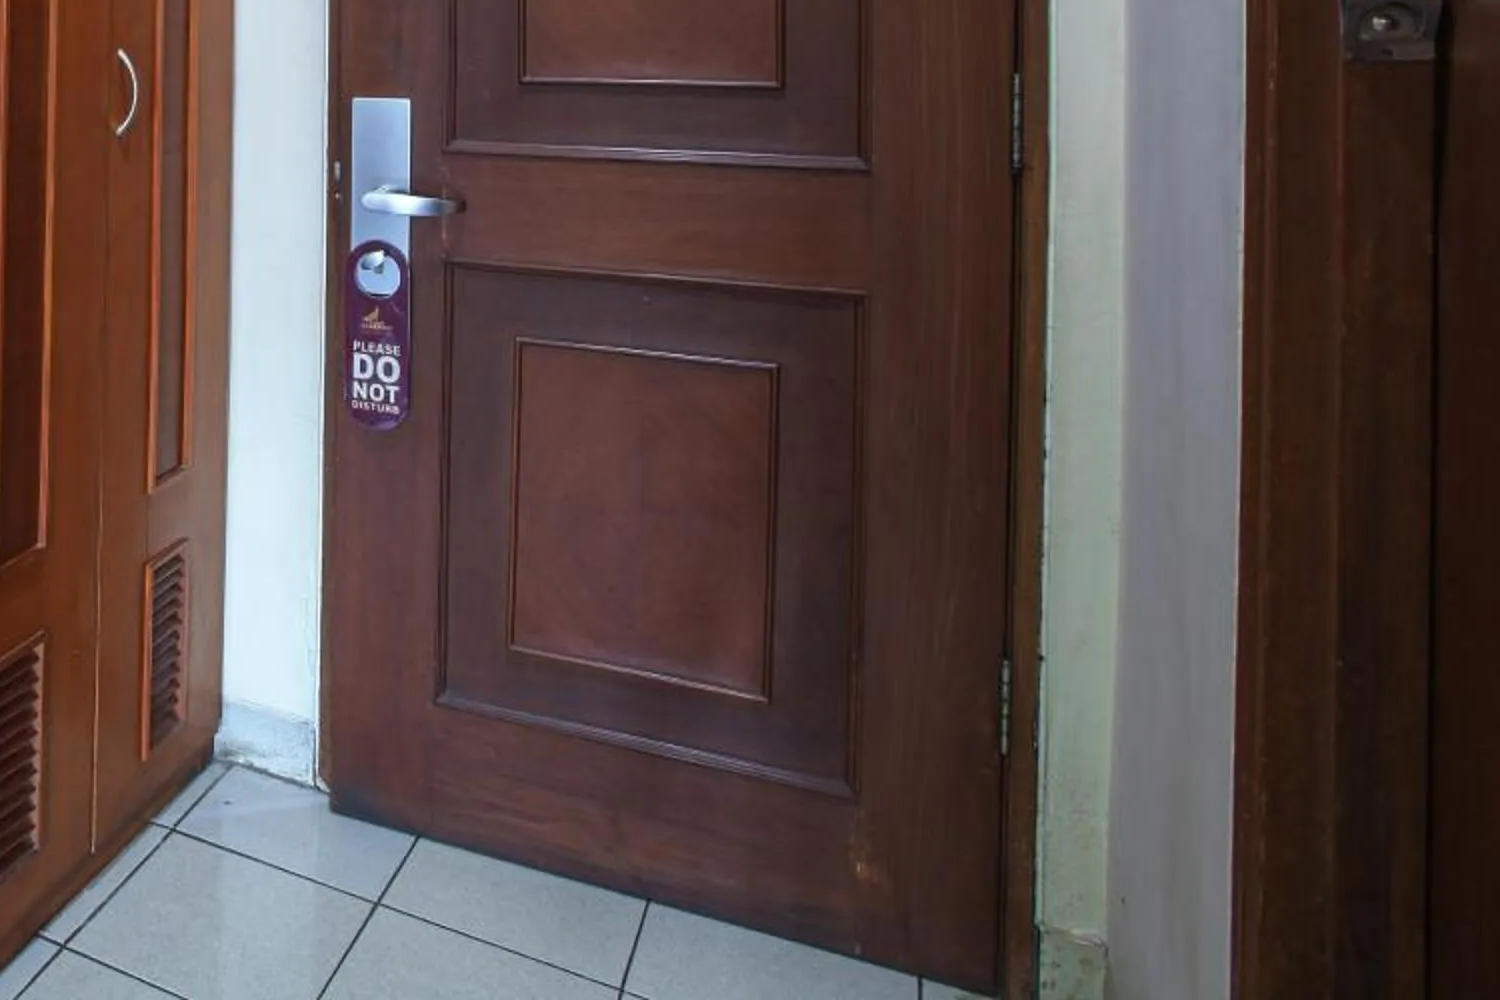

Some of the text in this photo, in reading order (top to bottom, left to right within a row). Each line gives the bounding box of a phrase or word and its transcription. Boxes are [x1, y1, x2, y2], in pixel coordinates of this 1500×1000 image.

[353, 339, 401, 356] PLEASE
[353, 352, 401, 383] DO
[352, 382, 401, 404] NOT
[351, 400, 400, 415] DISTURB
